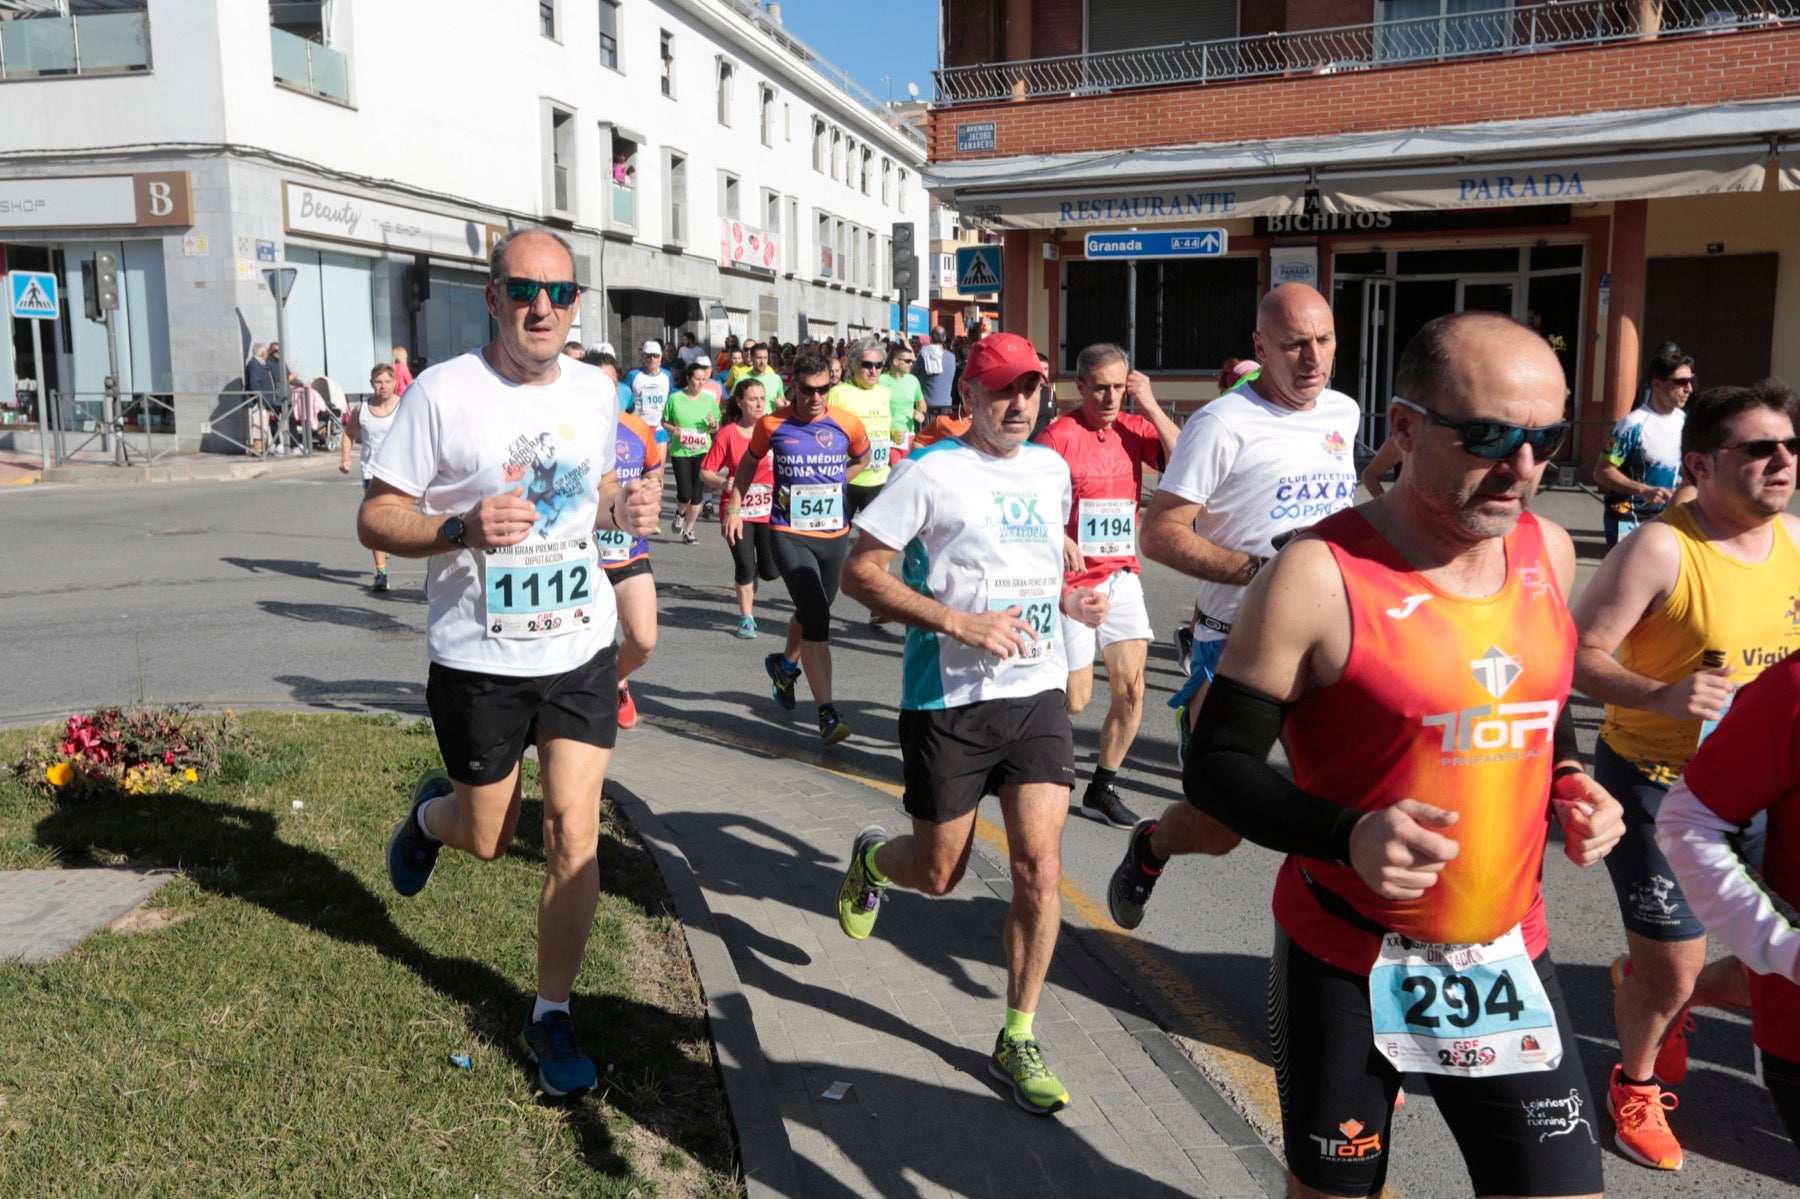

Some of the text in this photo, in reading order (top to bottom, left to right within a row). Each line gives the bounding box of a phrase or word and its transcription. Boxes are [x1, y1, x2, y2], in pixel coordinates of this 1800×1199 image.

[966, 124, 994, 133] AVENIDA
[968, 131, 992, 141] JACOBO
[960, 140, 994, 151] CAMARERO
[1458, 172, 1585, 202] PARADA
[300, 191, 362, 235] Beauty
[1059, 191, 1237, 223] RESTAURANTE
[1267, 211, 1393, 233] BICHITOS
[1088, 239, 1143, 252] Granada
[806, 452, 846, 464] MÉDUL
[1279, 474, 1308, 484] CLUB
[801, 498, 834, 516] 547
[1087, 518, 1131, 537] 1194
[515, 545, 534, 555] GRAN
[535, 543, 559, 554] PREMIO
[495, 565, 589, 608] 1112
[1401, 969, 1525, 1028] 294
[1521, 1098, 1566, 1110] Lojeños
[1527, 1116, 1567, 1127] running
